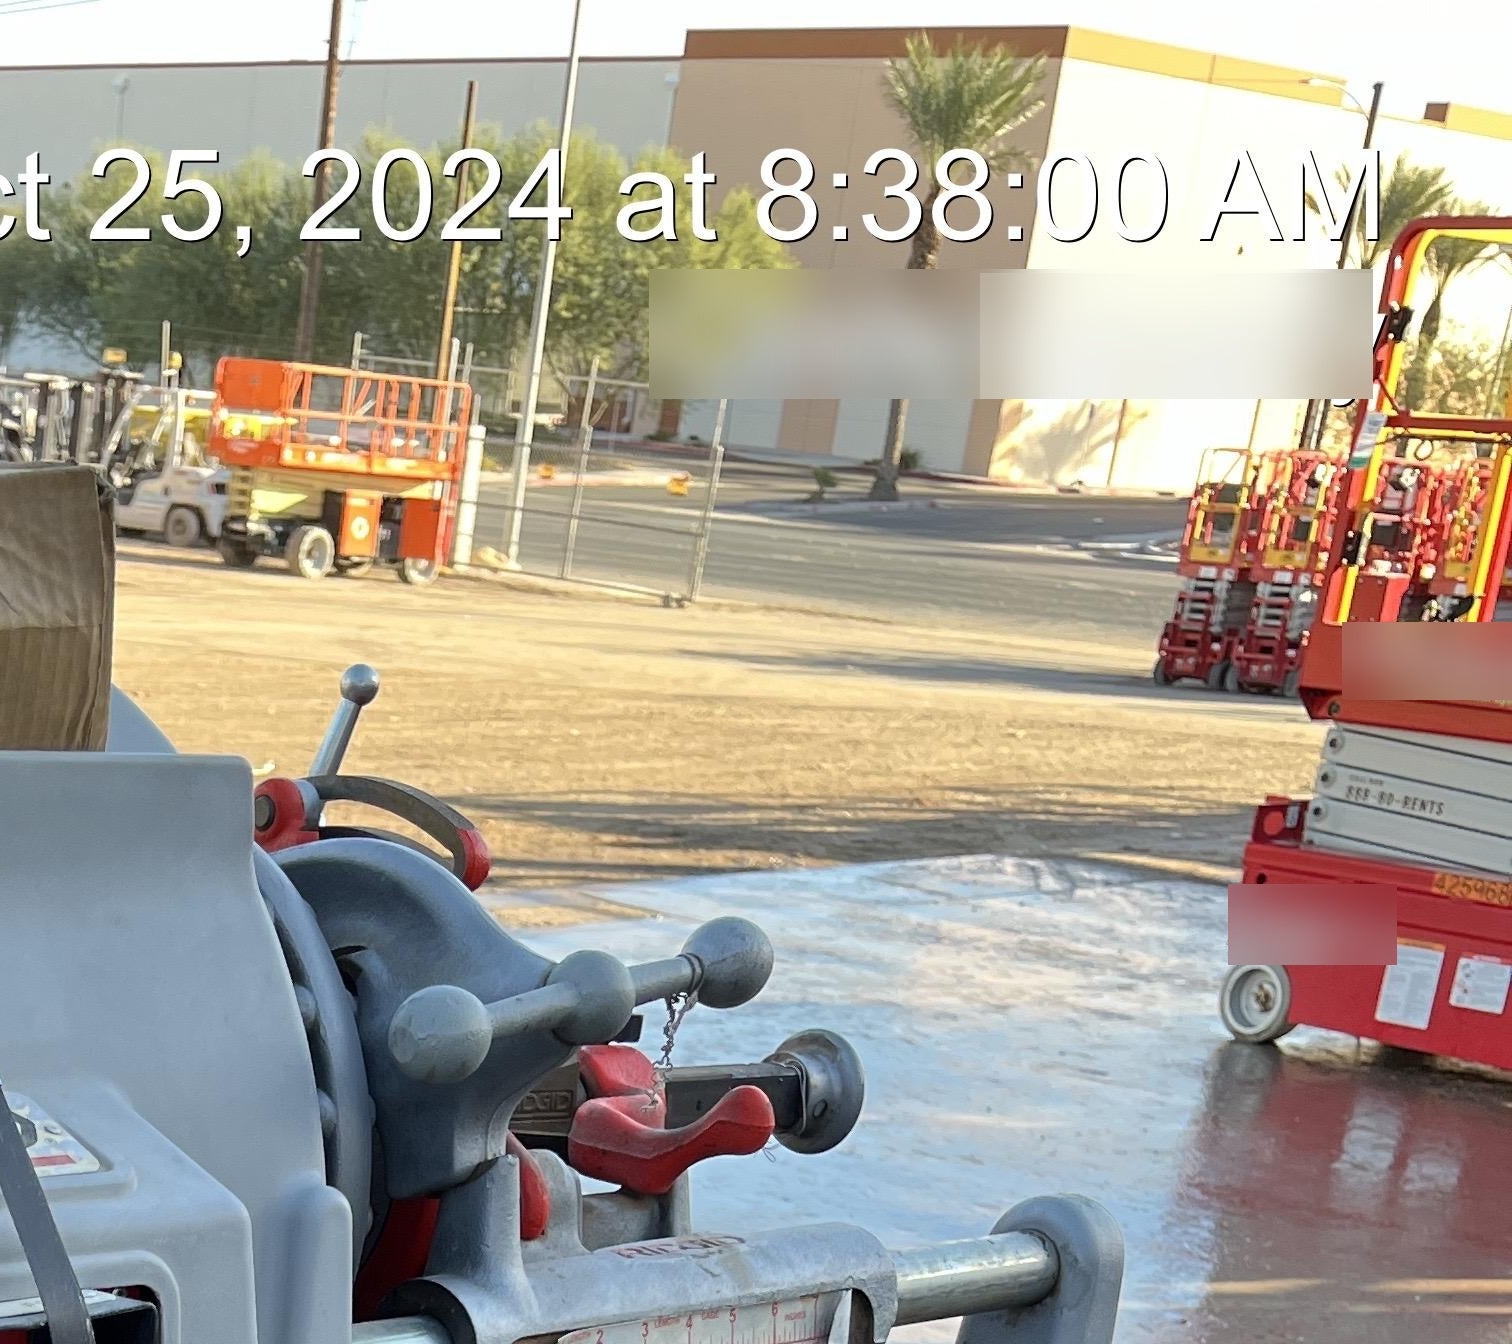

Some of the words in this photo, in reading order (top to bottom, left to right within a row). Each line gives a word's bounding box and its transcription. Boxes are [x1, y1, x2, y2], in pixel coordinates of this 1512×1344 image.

[596, 1329, 604, 1344] 2
[641, 1322, 649, 1338] 3
[729, 1307, 737, 1323] 5
[771, 1302, 778, 1317] 6
